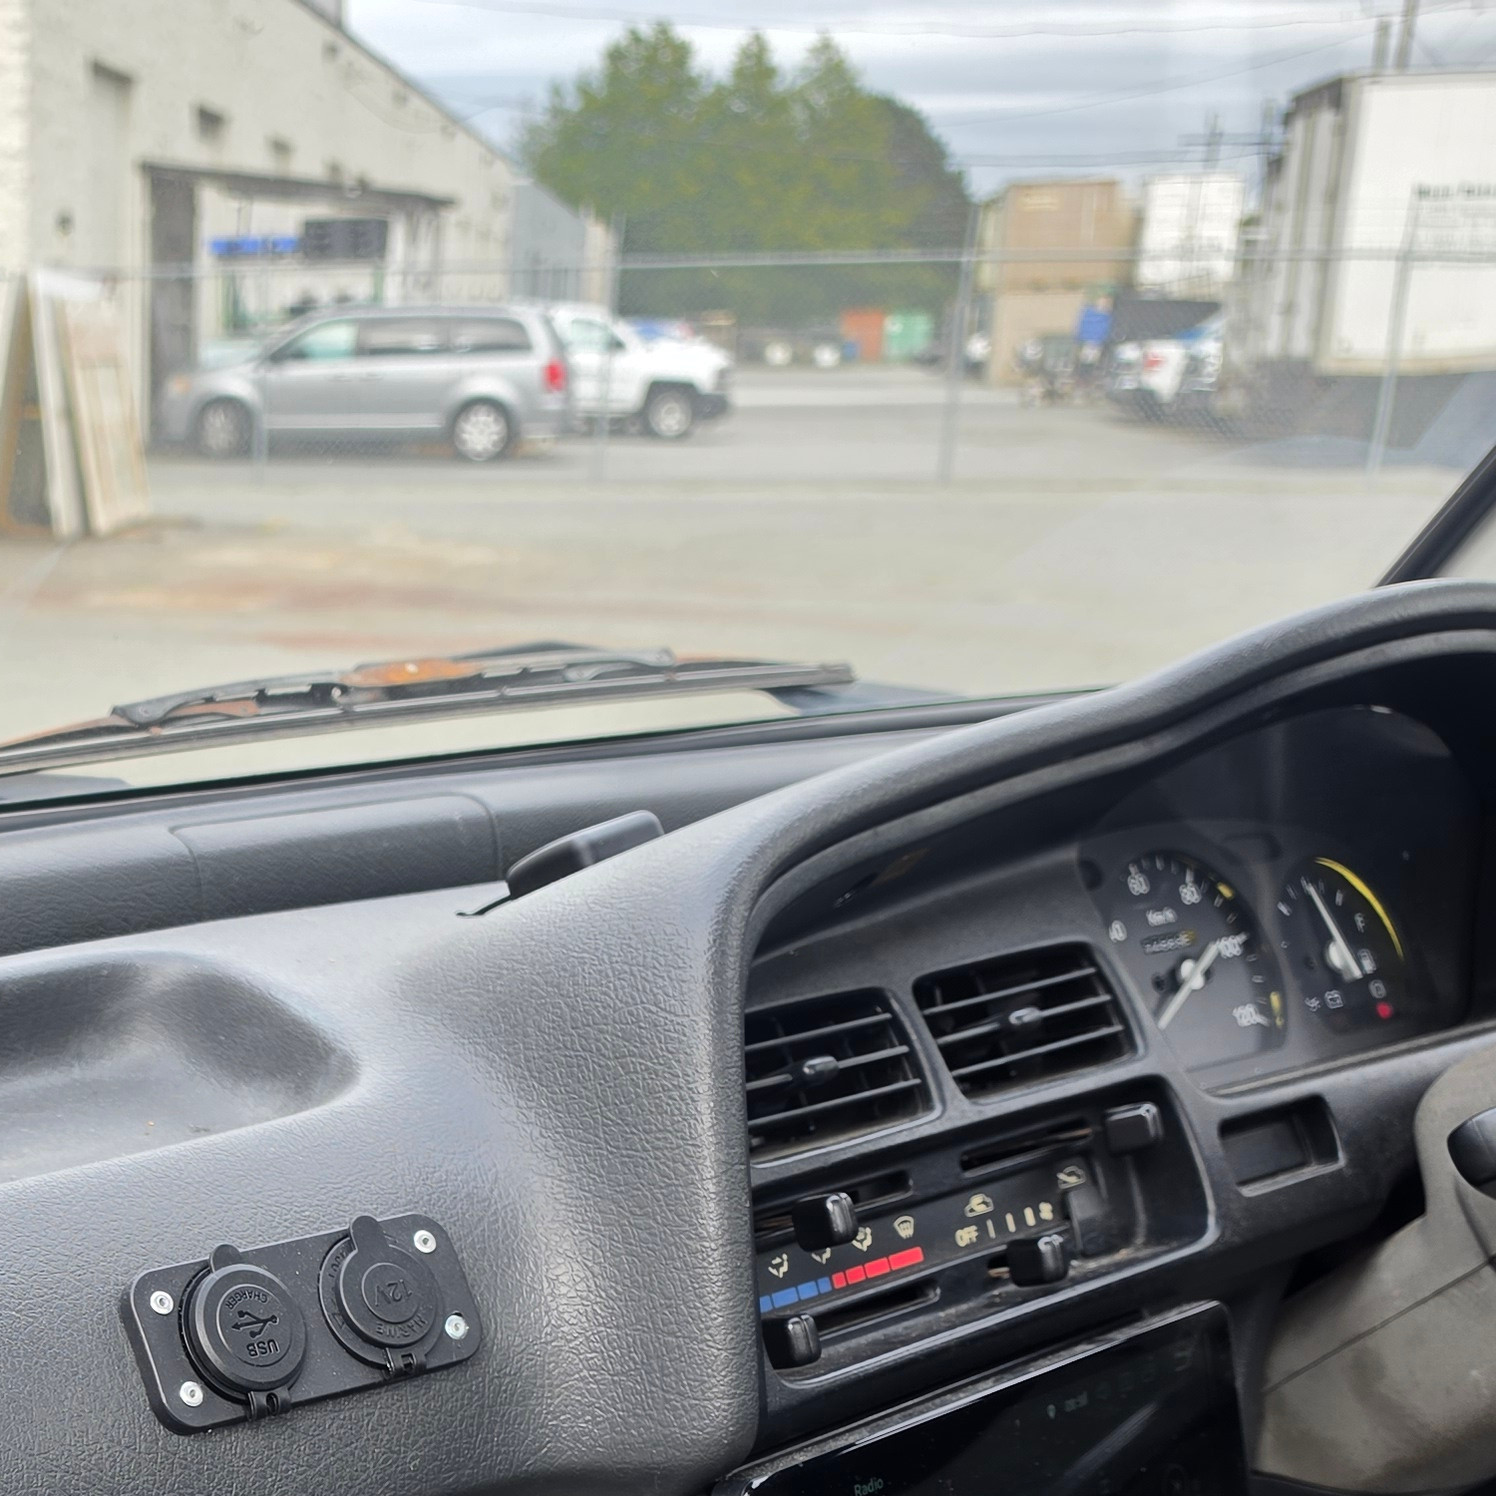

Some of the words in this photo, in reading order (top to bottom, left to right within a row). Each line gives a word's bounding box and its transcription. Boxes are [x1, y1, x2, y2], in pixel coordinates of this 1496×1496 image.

[955, 1225, 979, 1247] OFF
[224, 1289, 269, 1311] CHARGER
[375, 1279, 412, 1307] 12V
[246, 1339, 281, 1358] USB
